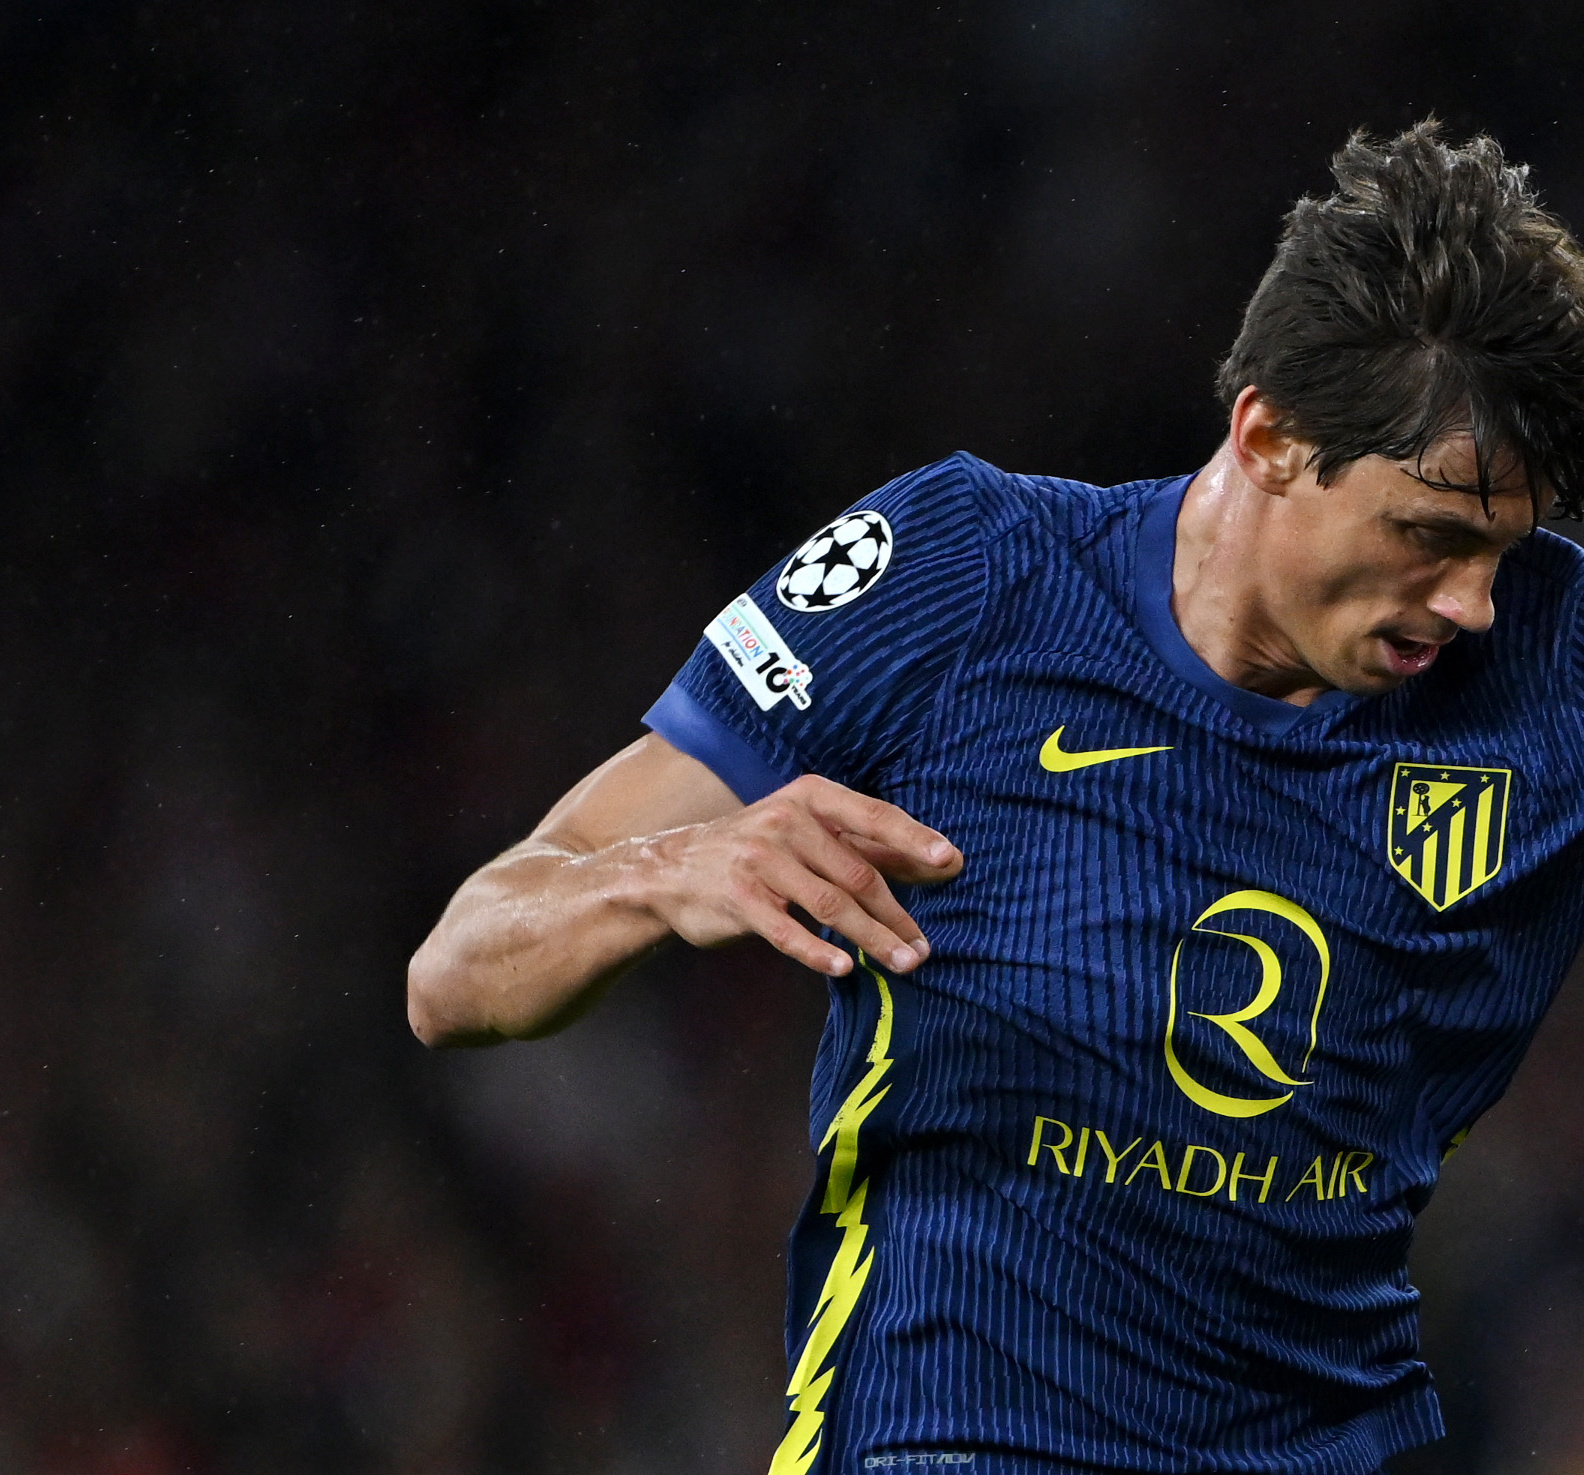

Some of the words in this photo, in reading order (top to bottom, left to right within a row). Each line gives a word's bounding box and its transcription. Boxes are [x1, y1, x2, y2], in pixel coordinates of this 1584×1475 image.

[756, 652, 791, 693] 10
[1026, 1115, 1278, 1203] RIYADH
[1285, 1150, 1374, 1202] AIR
